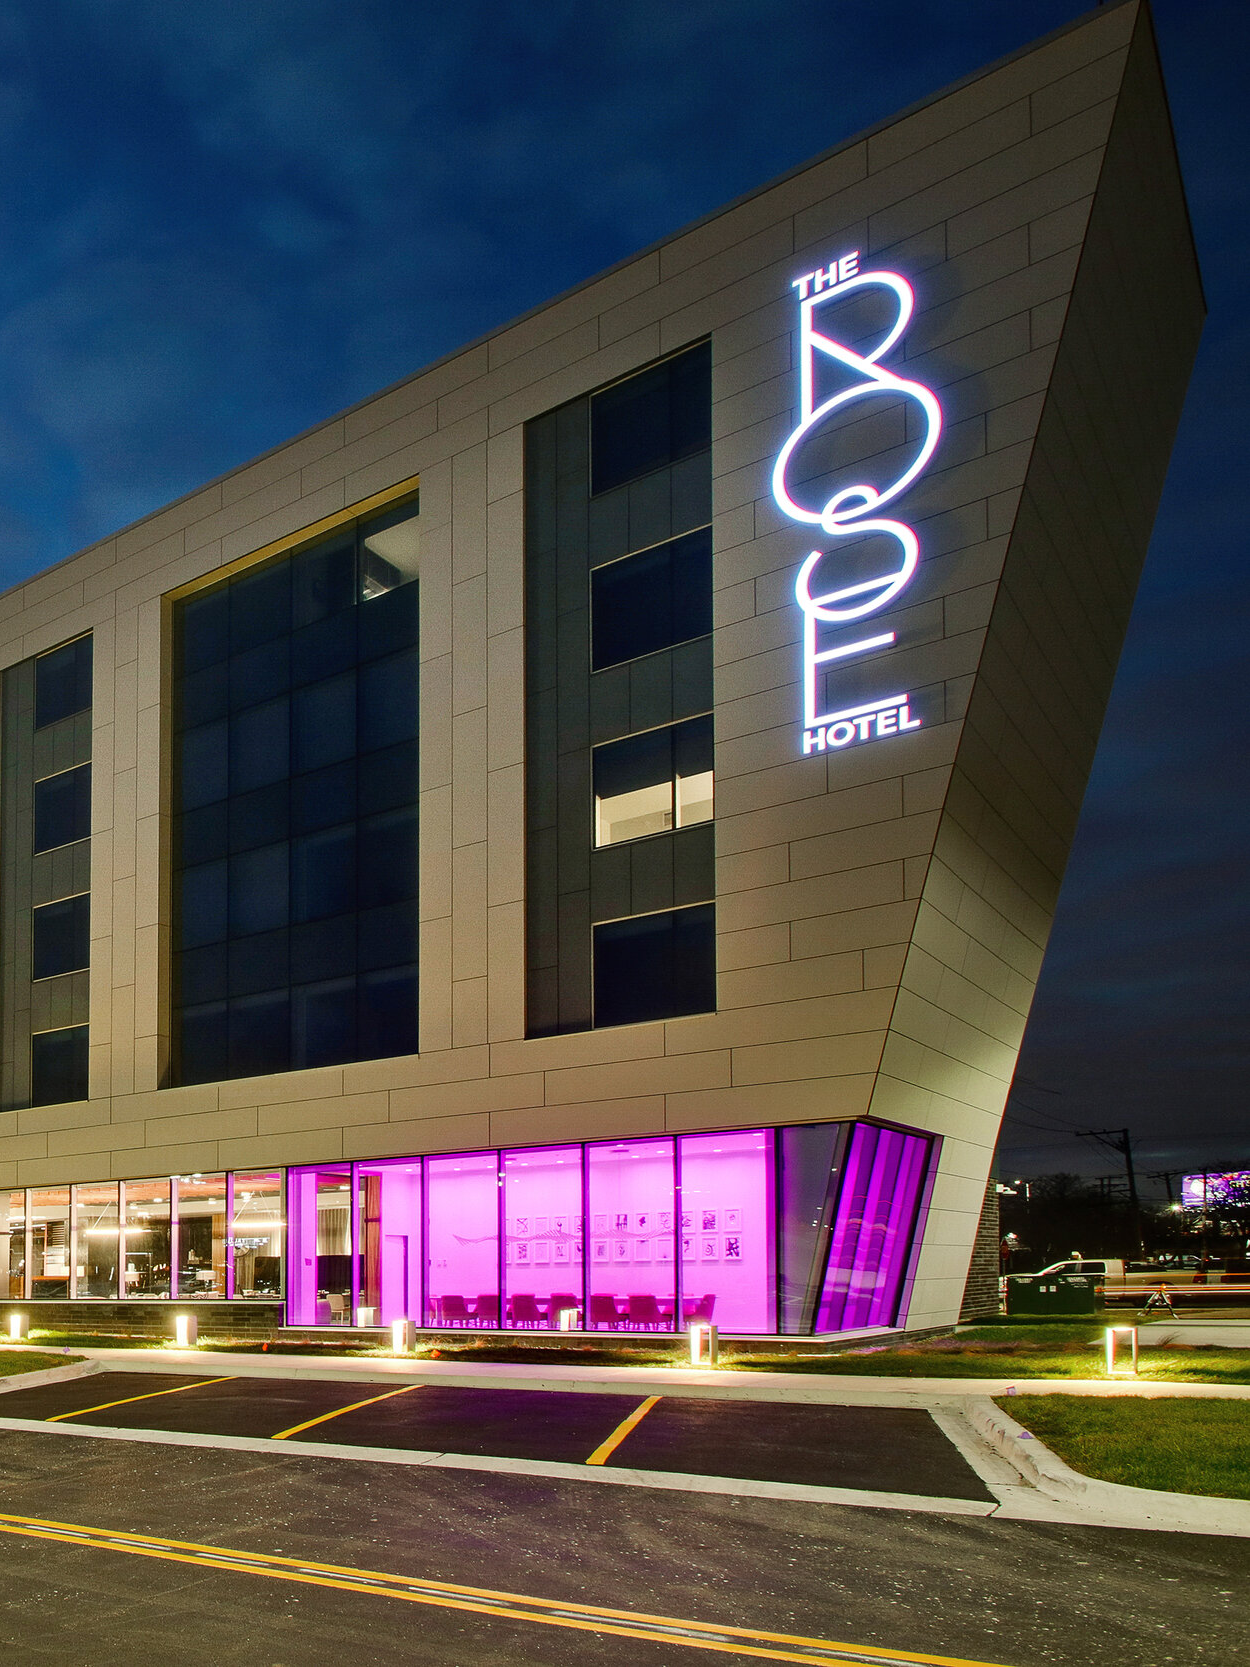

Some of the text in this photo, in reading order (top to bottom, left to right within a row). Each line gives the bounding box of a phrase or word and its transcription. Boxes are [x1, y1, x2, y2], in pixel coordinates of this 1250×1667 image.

[791, 250, 860, 301] THE
[772, 270, 942, 729] ROSE
[802, 705, 922, 754] HOTEL
